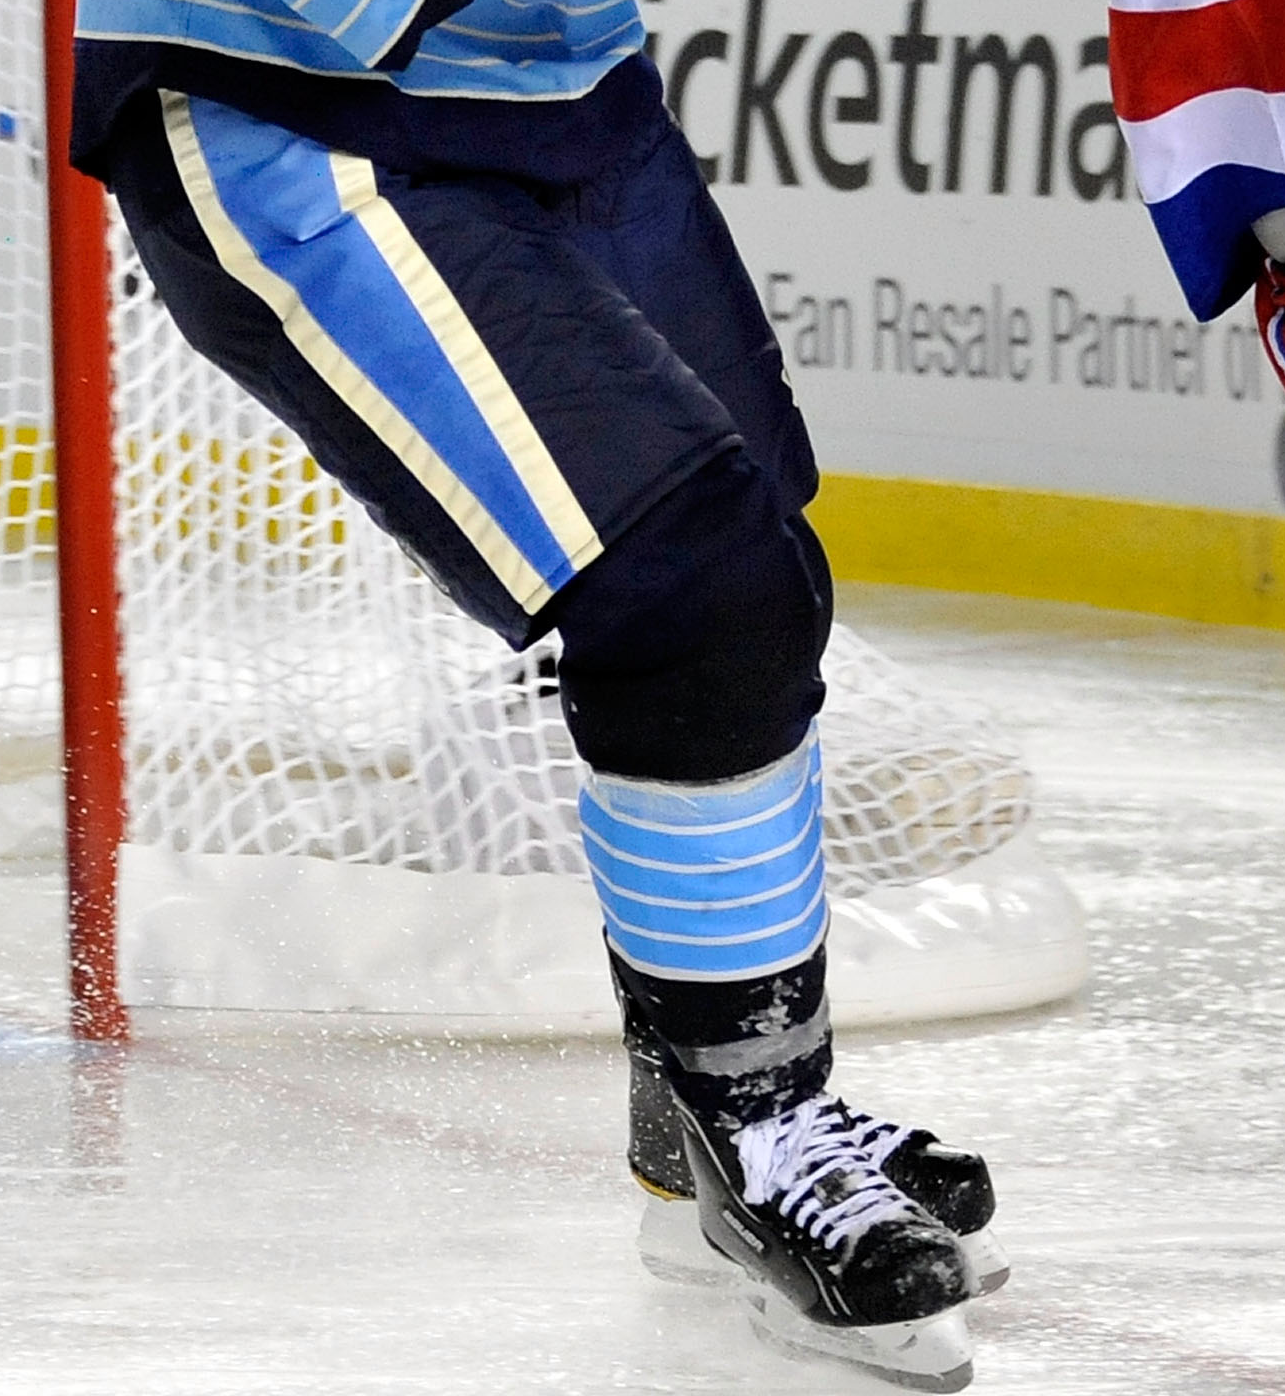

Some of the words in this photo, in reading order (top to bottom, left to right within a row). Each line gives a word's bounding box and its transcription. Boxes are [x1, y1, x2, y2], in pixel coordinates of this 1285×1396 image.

[767, 272, 853, 370] Fan
[873, 277, 1029, 381] Resale
[1052, 287, 1207, 397] Partner
